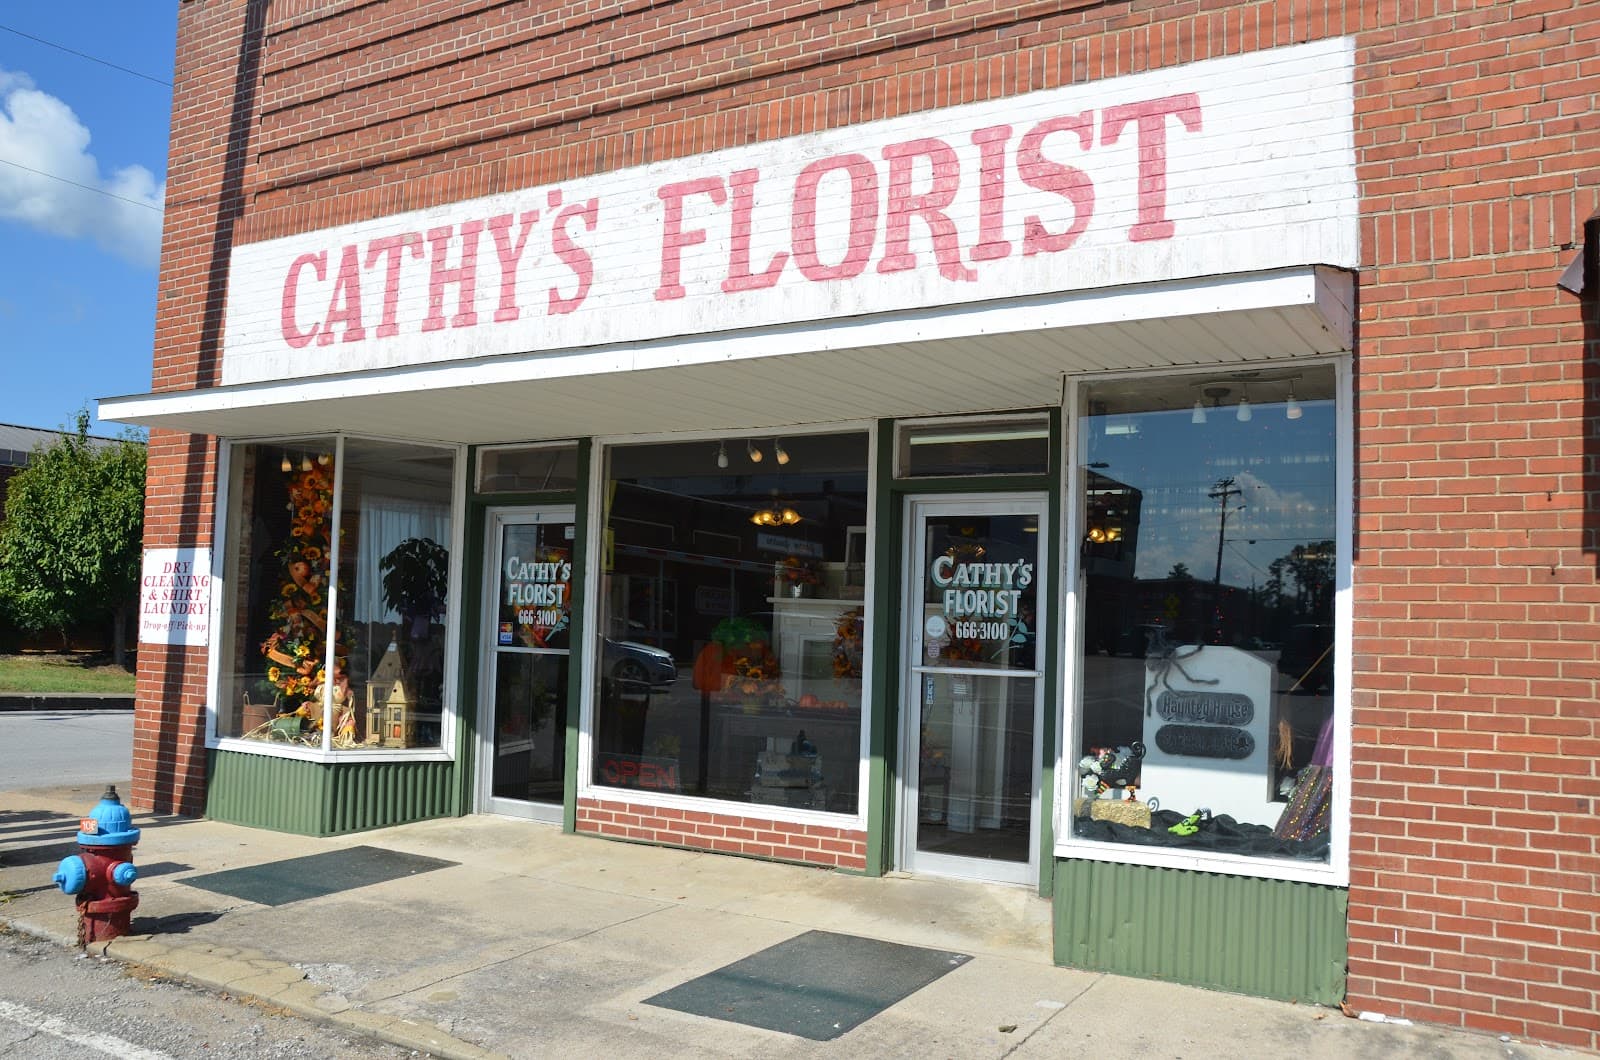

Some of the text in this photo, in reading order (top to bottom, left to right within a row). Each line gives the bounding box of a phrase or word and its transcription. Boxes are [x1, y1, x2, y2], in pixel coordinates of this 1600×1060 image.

[281, 92, 1203, 349] CATHY'S FLORIST
[163, 561, 192, 574] DRY
[506, 556, 572, 582] CATHY'S
[931, 555, 1033, 588] CATHY'S
[143, 575, 209, 588] CLEANING
[148, 588, 203, 601] & SHIRT
[507, 583, 566, 607] FLORIST
[943, 589, 1022, 618] FLORIST
[143, 602, 207, 615] LAUNDRY
[603, 759, 676, 790] OPEN
